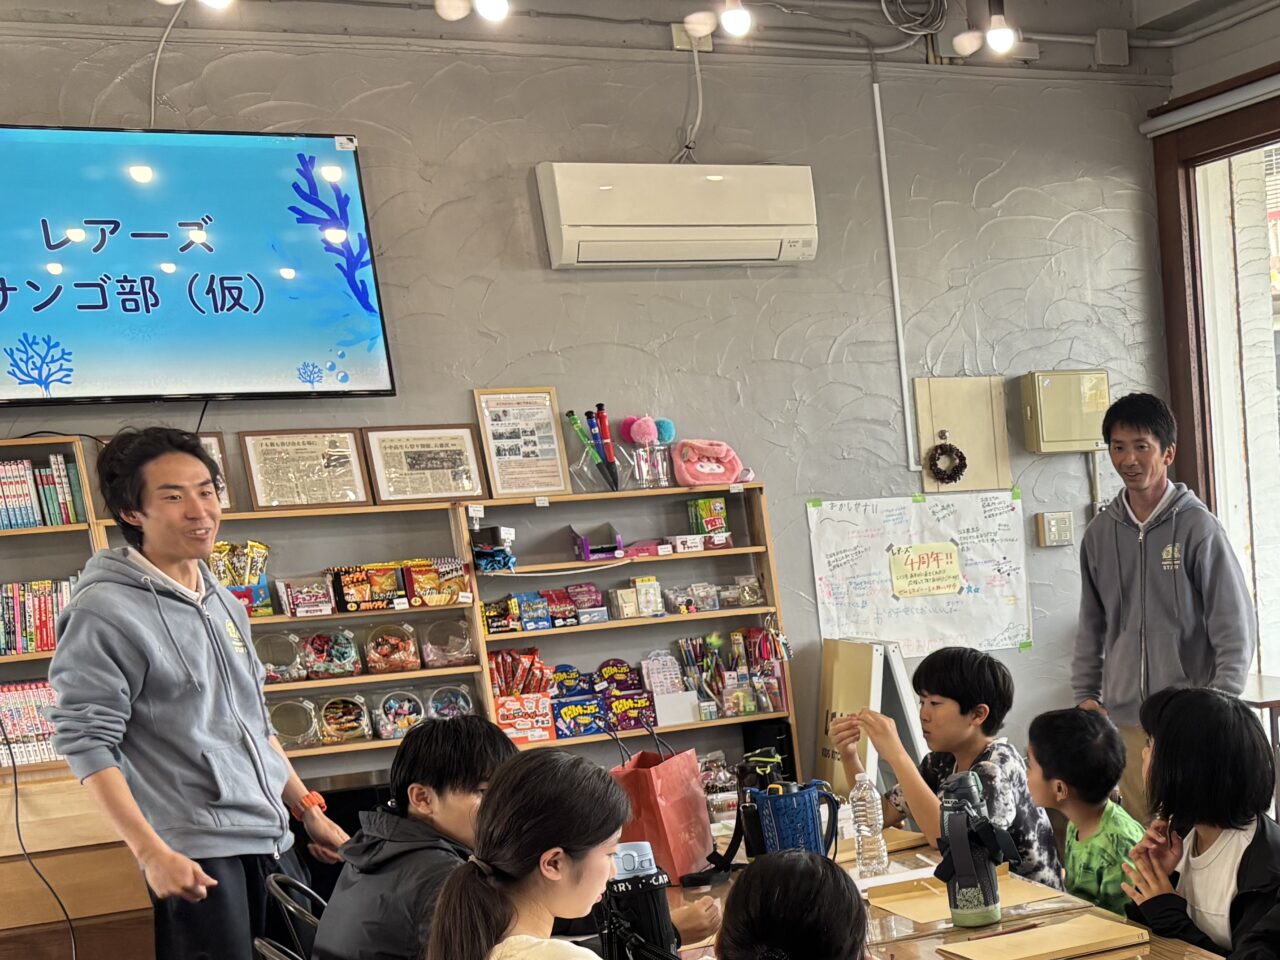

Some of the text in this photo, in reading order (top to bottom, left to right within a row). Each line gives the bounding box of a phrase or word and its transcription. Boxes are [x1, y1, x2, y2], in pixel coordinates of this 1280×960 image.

[41, 215, 214, 253] レアーズ
[904, 551, 953, 571] 4周年!!
